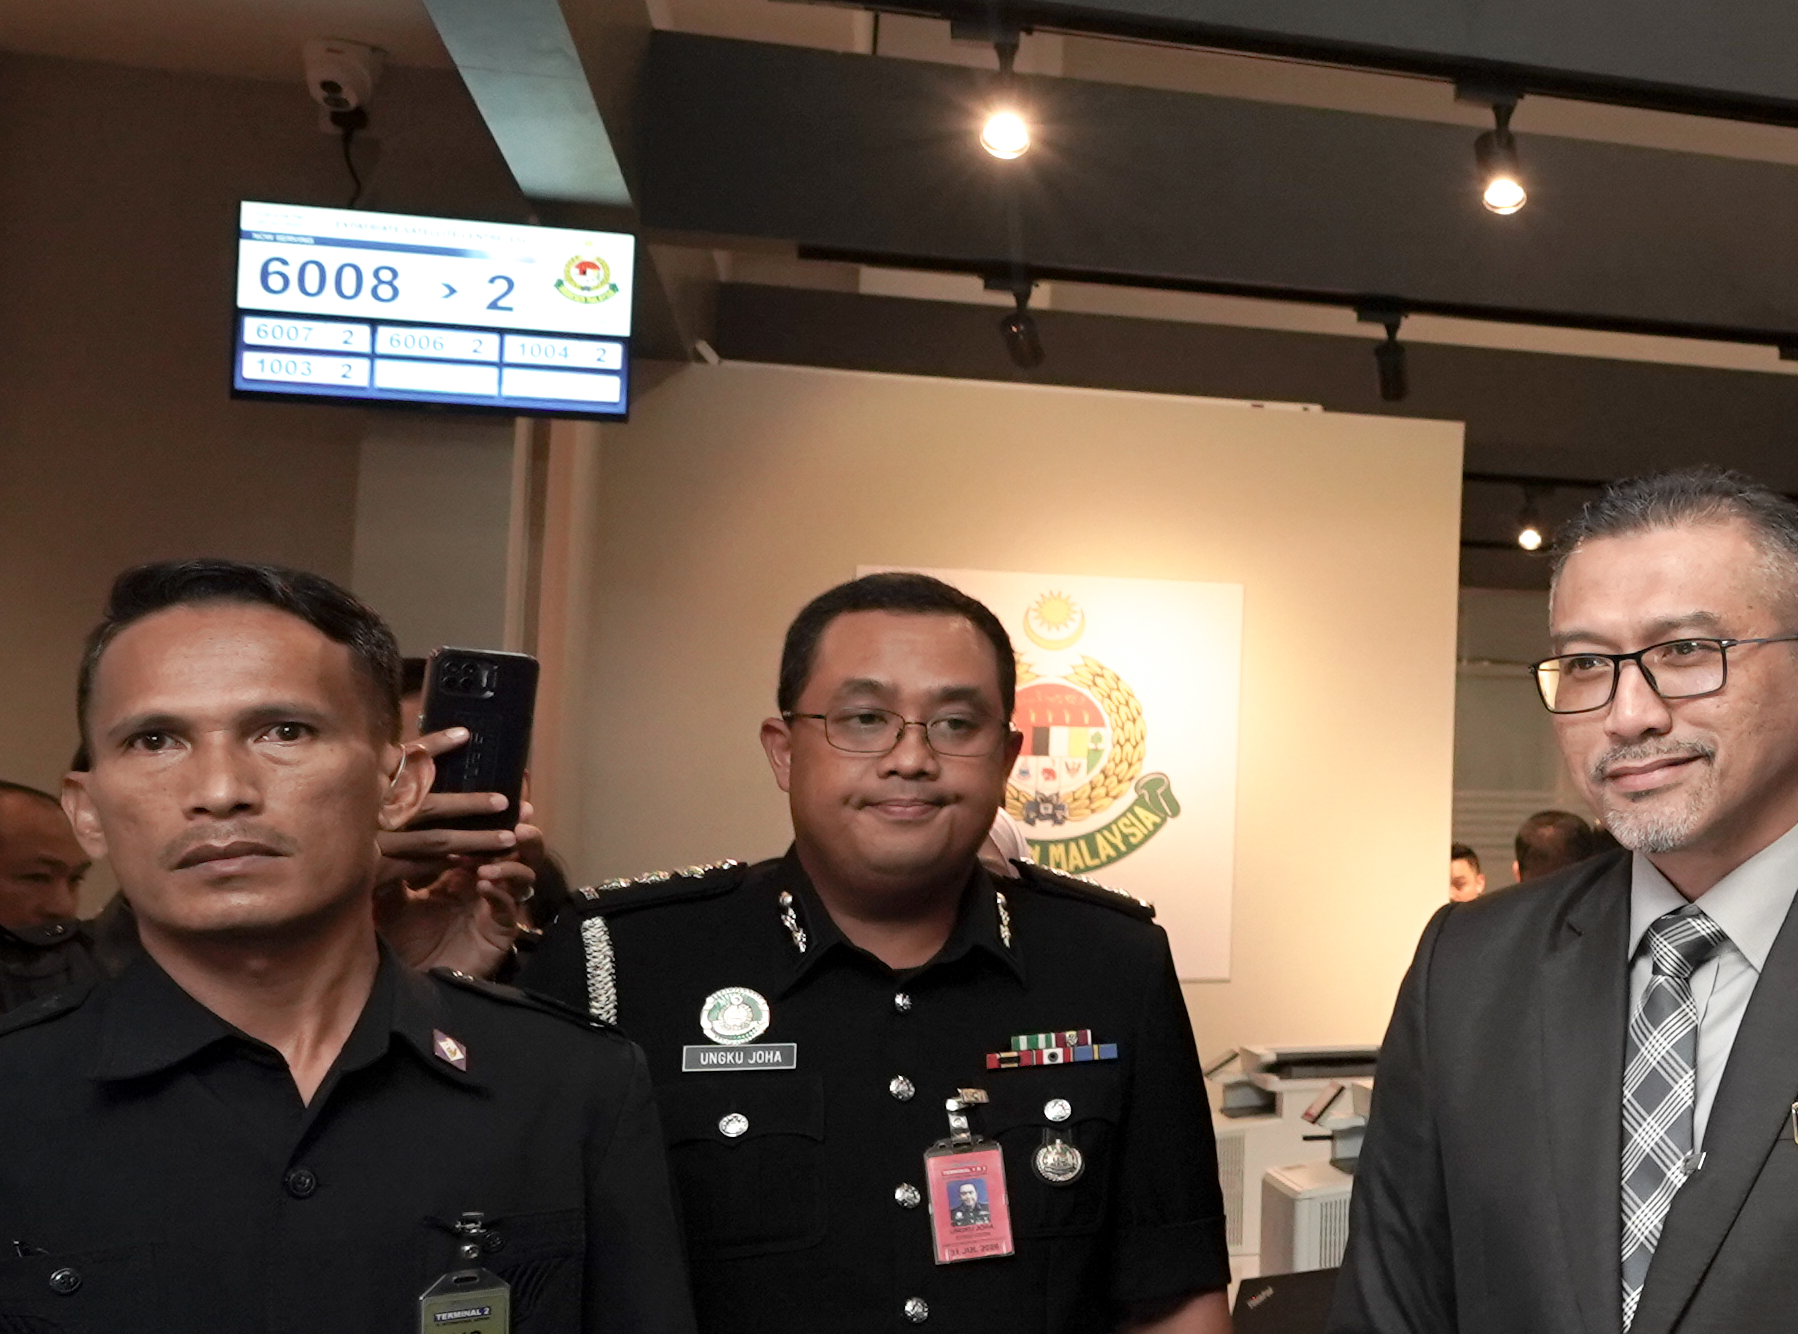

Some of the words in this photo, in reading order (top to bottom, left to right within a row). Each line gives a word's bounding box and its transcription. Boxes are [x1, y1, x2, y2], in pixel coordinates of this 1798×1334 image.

[258, 255, 401, 304] 6008
[485, 274, 517, 313] 2
[255, 323, 314, 343] 6007
[341, 329, 354, 346] 2
[389, 333, 445, 352] 6006
[471, 338, 484, 355] 2
[518, 342, 570, 361] 1004
[596, 347, 608, 363] 2
[256, 358, 313, 377] 1003
[340, 364, 353, 380] 2
[1049, 805, 1162, 874] MALAYSIA
[700, 1051, 744, 1065] UNGKU
[747, 1050, 782, 1064] JOHA
[436, 1308, 482, 1322] TERMINAL
[484, 1307, 490, 1316] 2
